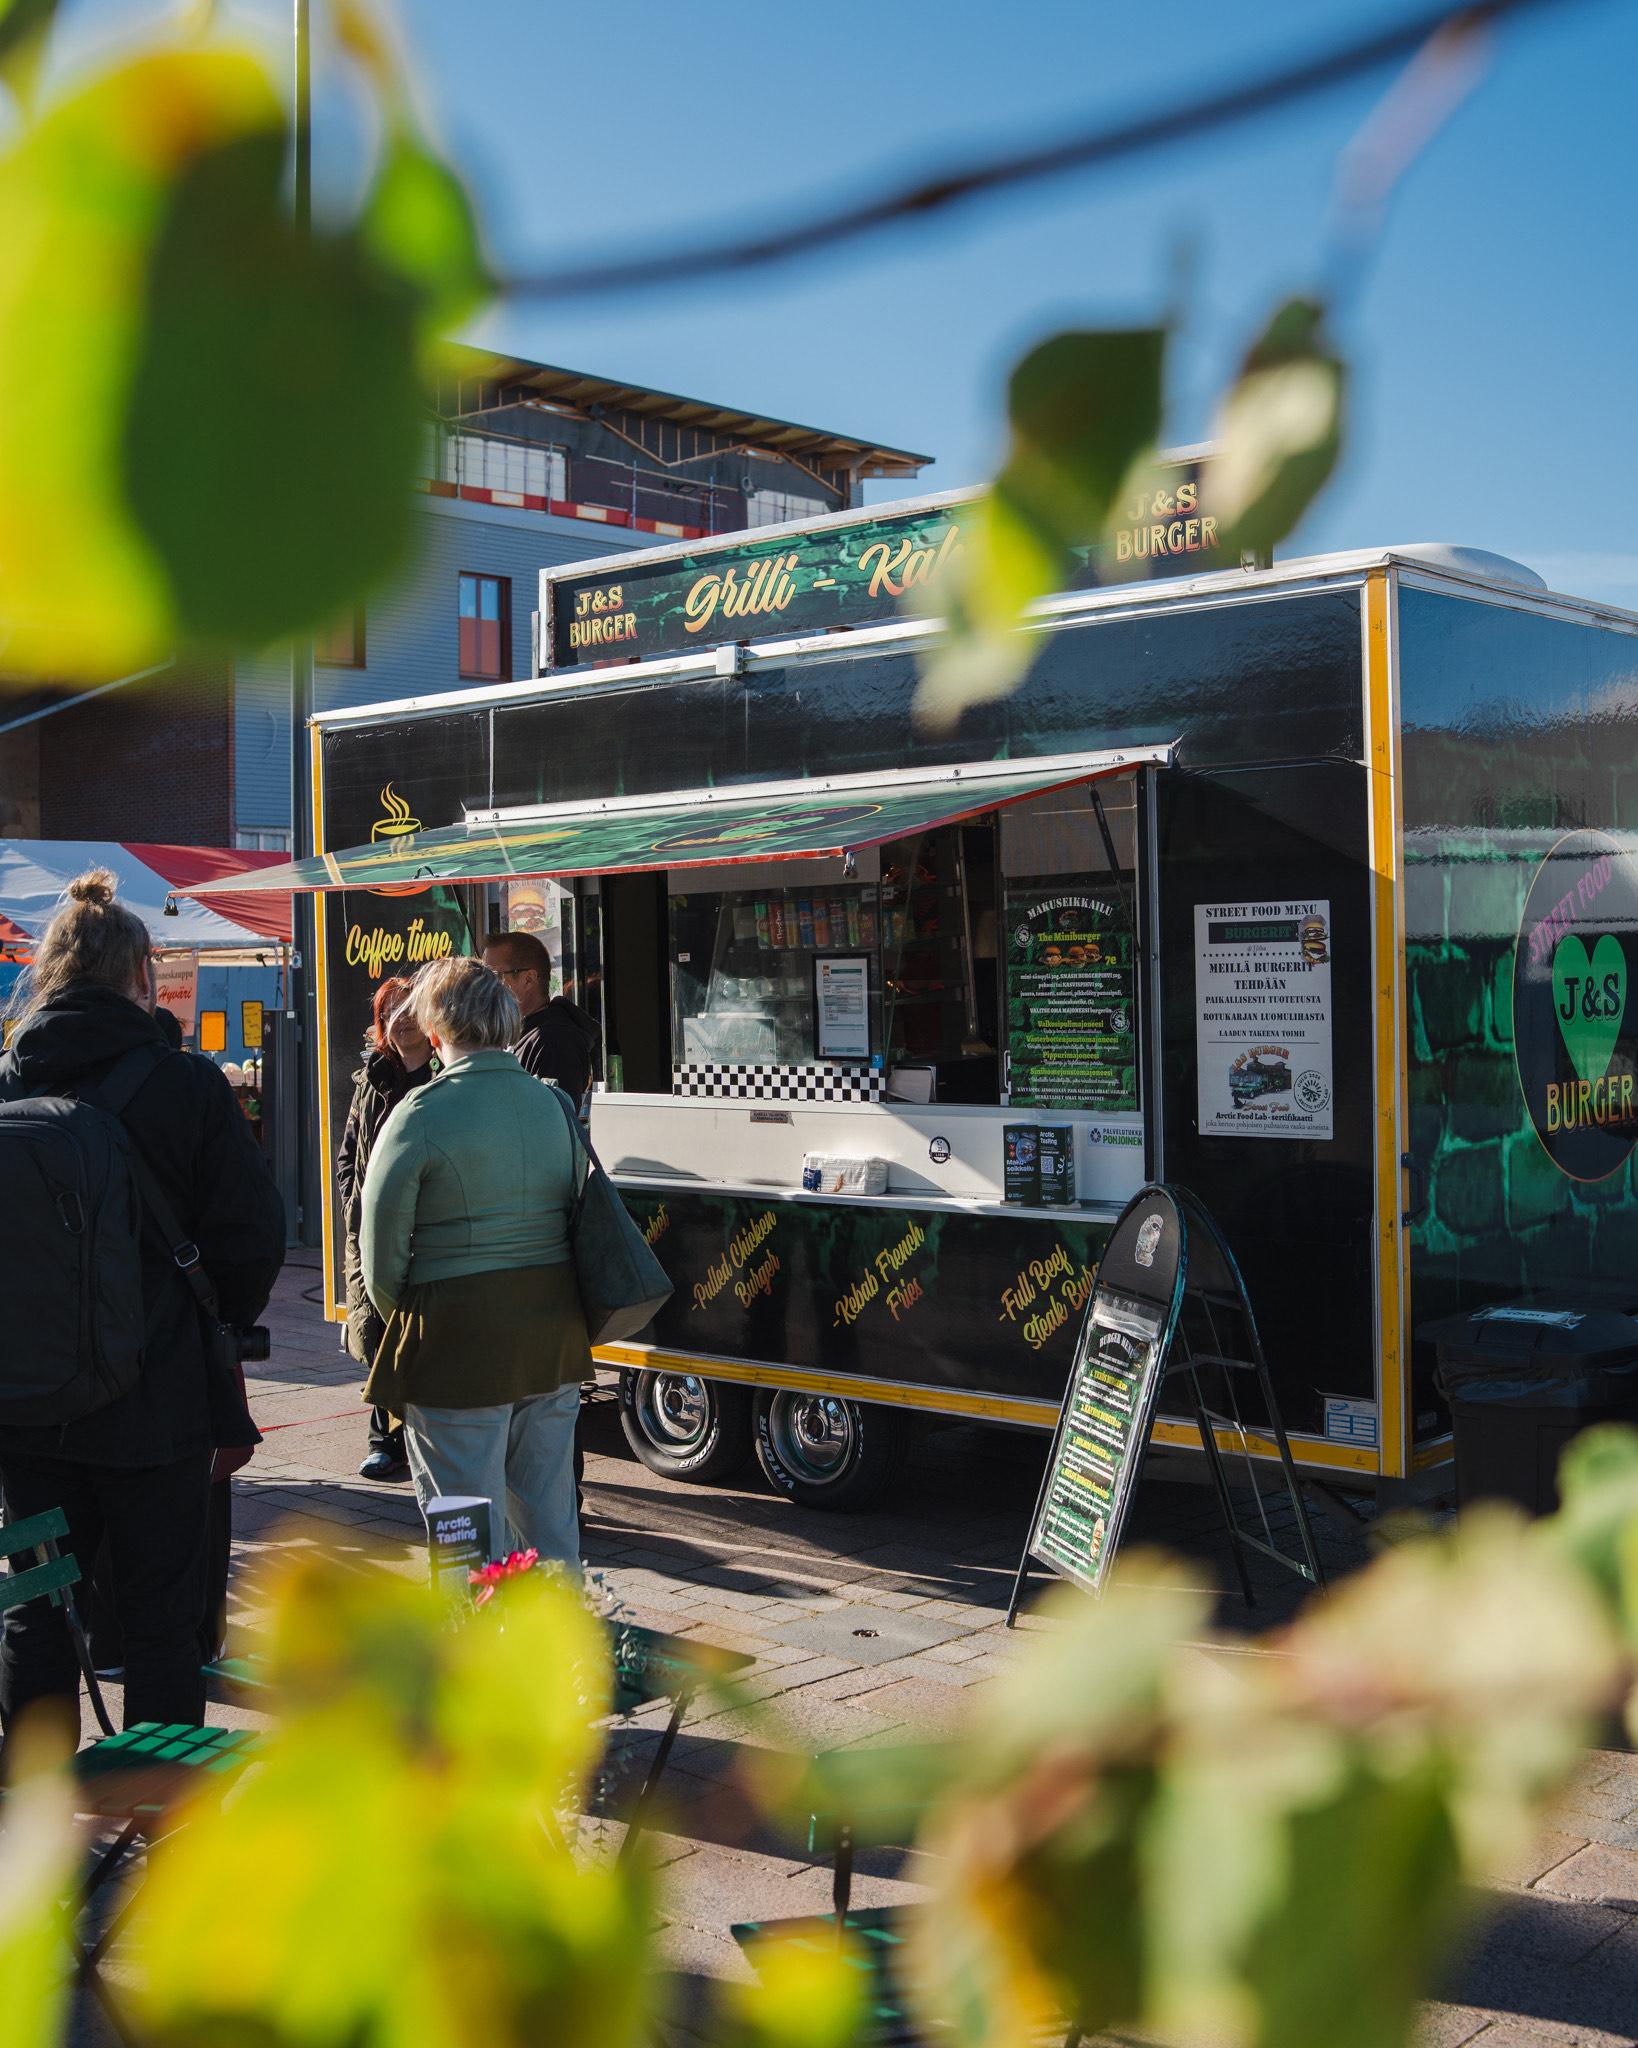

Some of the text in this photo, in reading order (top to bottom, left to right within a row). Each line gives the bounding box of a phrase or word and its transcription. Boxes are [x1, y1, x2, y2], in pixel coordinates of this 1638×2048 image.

[1127, 482, 1199, 521] J&S
[1116, 517, 1221, 562] BURGER
[576, 585, 624, 616] J&S
[684, 554, 799, 633] Grilli
[569, 612, 638, 649] BURGER
[1027, 897, 1113, 920] MAKUSEIKKAILU
[1206, 904, 1317, 918] STREET FOOD MENU
[1527, 855, 1613, 962] STREET FOOD
[1038, 931, 1101, 943] The Miniburger
[1225, 926, 1292, 939] BURGERIT
[346, 918, 453, 980] Coffee time
[1209, 961, 1313, 973] MEILLÄ BURGERIT
[157, 985, 193, 1004] Hyväri
[1234, 977, 1287, 990] TEHDÄÄN
[1560, 972, 1621, 1025] J&S
[1205, 995, 1321, 1004] PAIKALLISESTI TUOTETUSTA
[1038, 1020, 1104, 1030] Valkosipulimajoneesi
[1203, 1013, 1325, 1021] ROTUKARJAN LUOMULIHASTA
[1043, 1051, 1100, 1061] Pippurimajoneesi
[1237, 1112, 1254, 1120] Food
[1255, 1112, 1267, 1120] Lab
[1271, 1113, 1313, 1122] sertifikaatti
[1546, 1074, 1635, 1136] BURGER
[1102, 1136, 1143, 1146] POHJOINEN
[729, 1210, 777, 1268] Chicken
[875, 1220, 925, 1283] French
[734, 1249, 781, 1309] Burger
[1029, 1243, 1075, 1291] Beef
[886, 1277, 924, 1321] Fries
[1023, 1295, 1068, 1350] Steak
[760, 1415, 795, 1490] VITOUR
[436, 1516, 471, 1532] Arctic
[436, 1527, 477, 1545] Tasting
